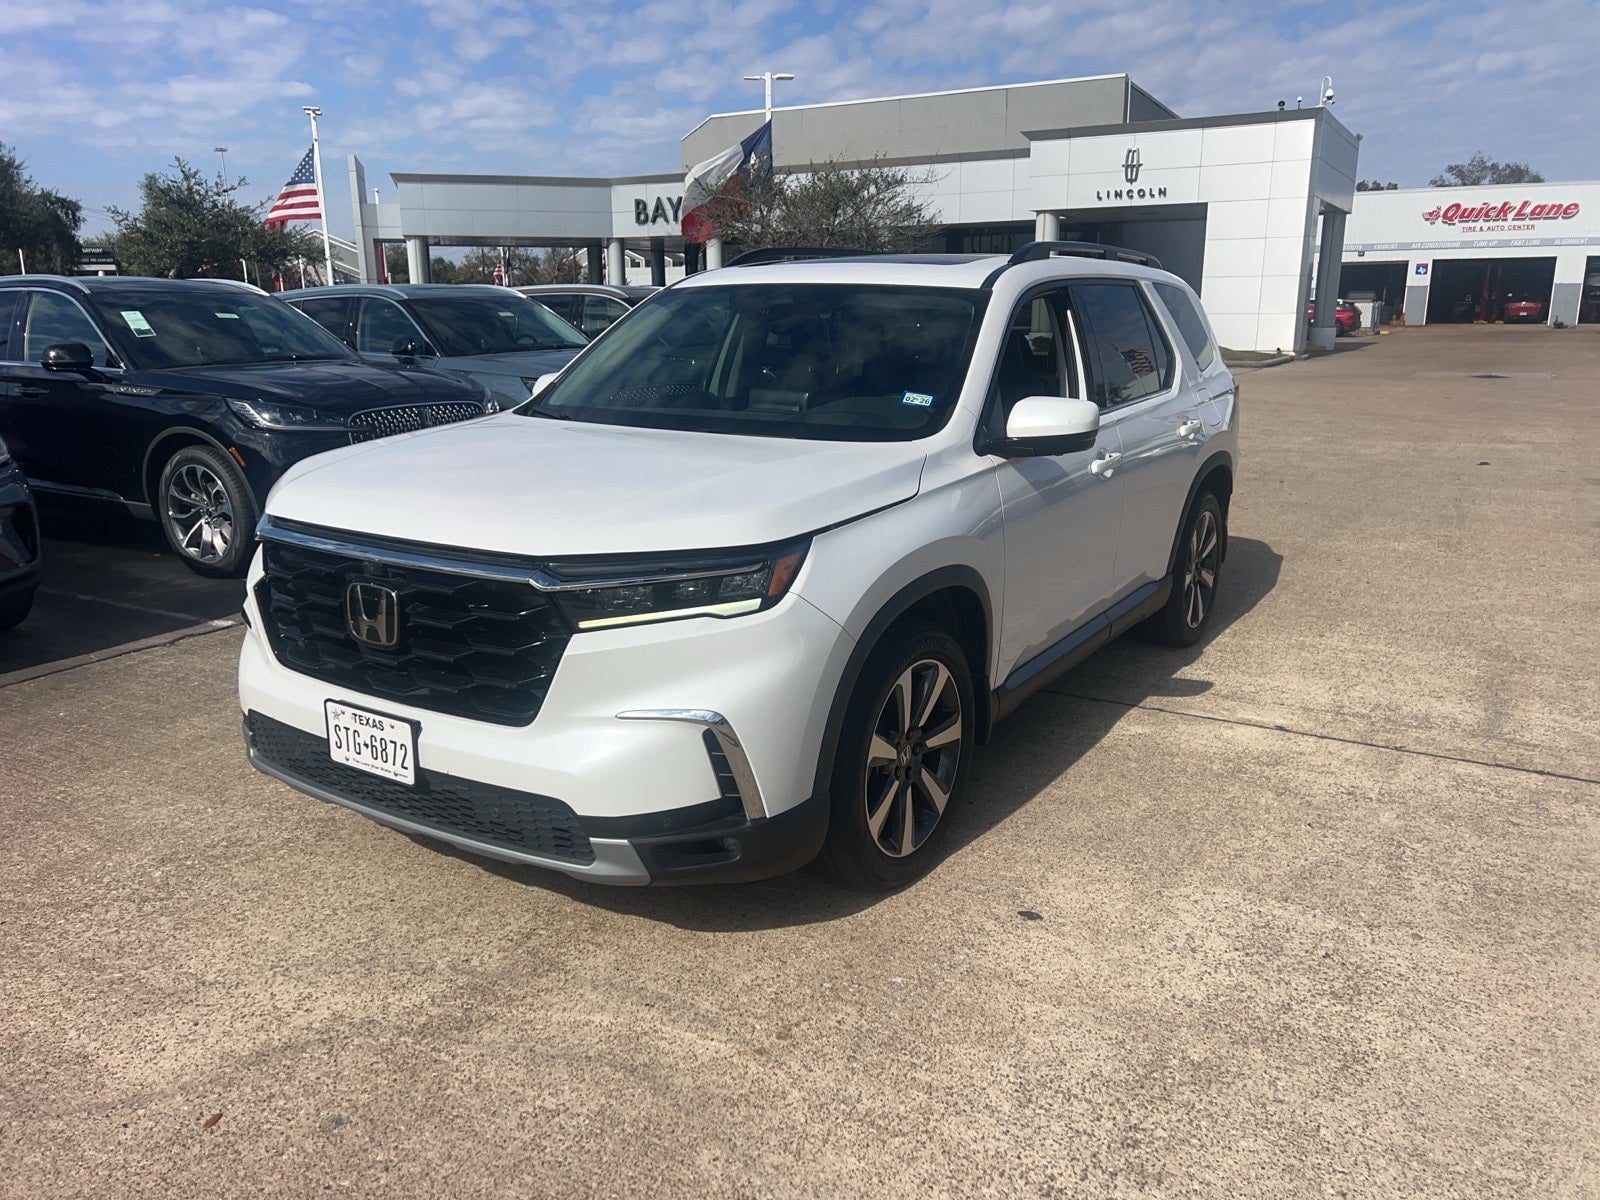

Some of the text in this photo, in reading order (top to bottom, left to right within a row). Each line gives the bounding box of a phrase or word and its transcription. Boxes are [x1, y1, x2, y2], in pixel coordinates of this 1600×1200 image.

[1096, 187, 1167, 202] LINCOLN
[1442, 201, 1580, 225] Quick Lane
[352, 713, 384, 731] TEXAS
